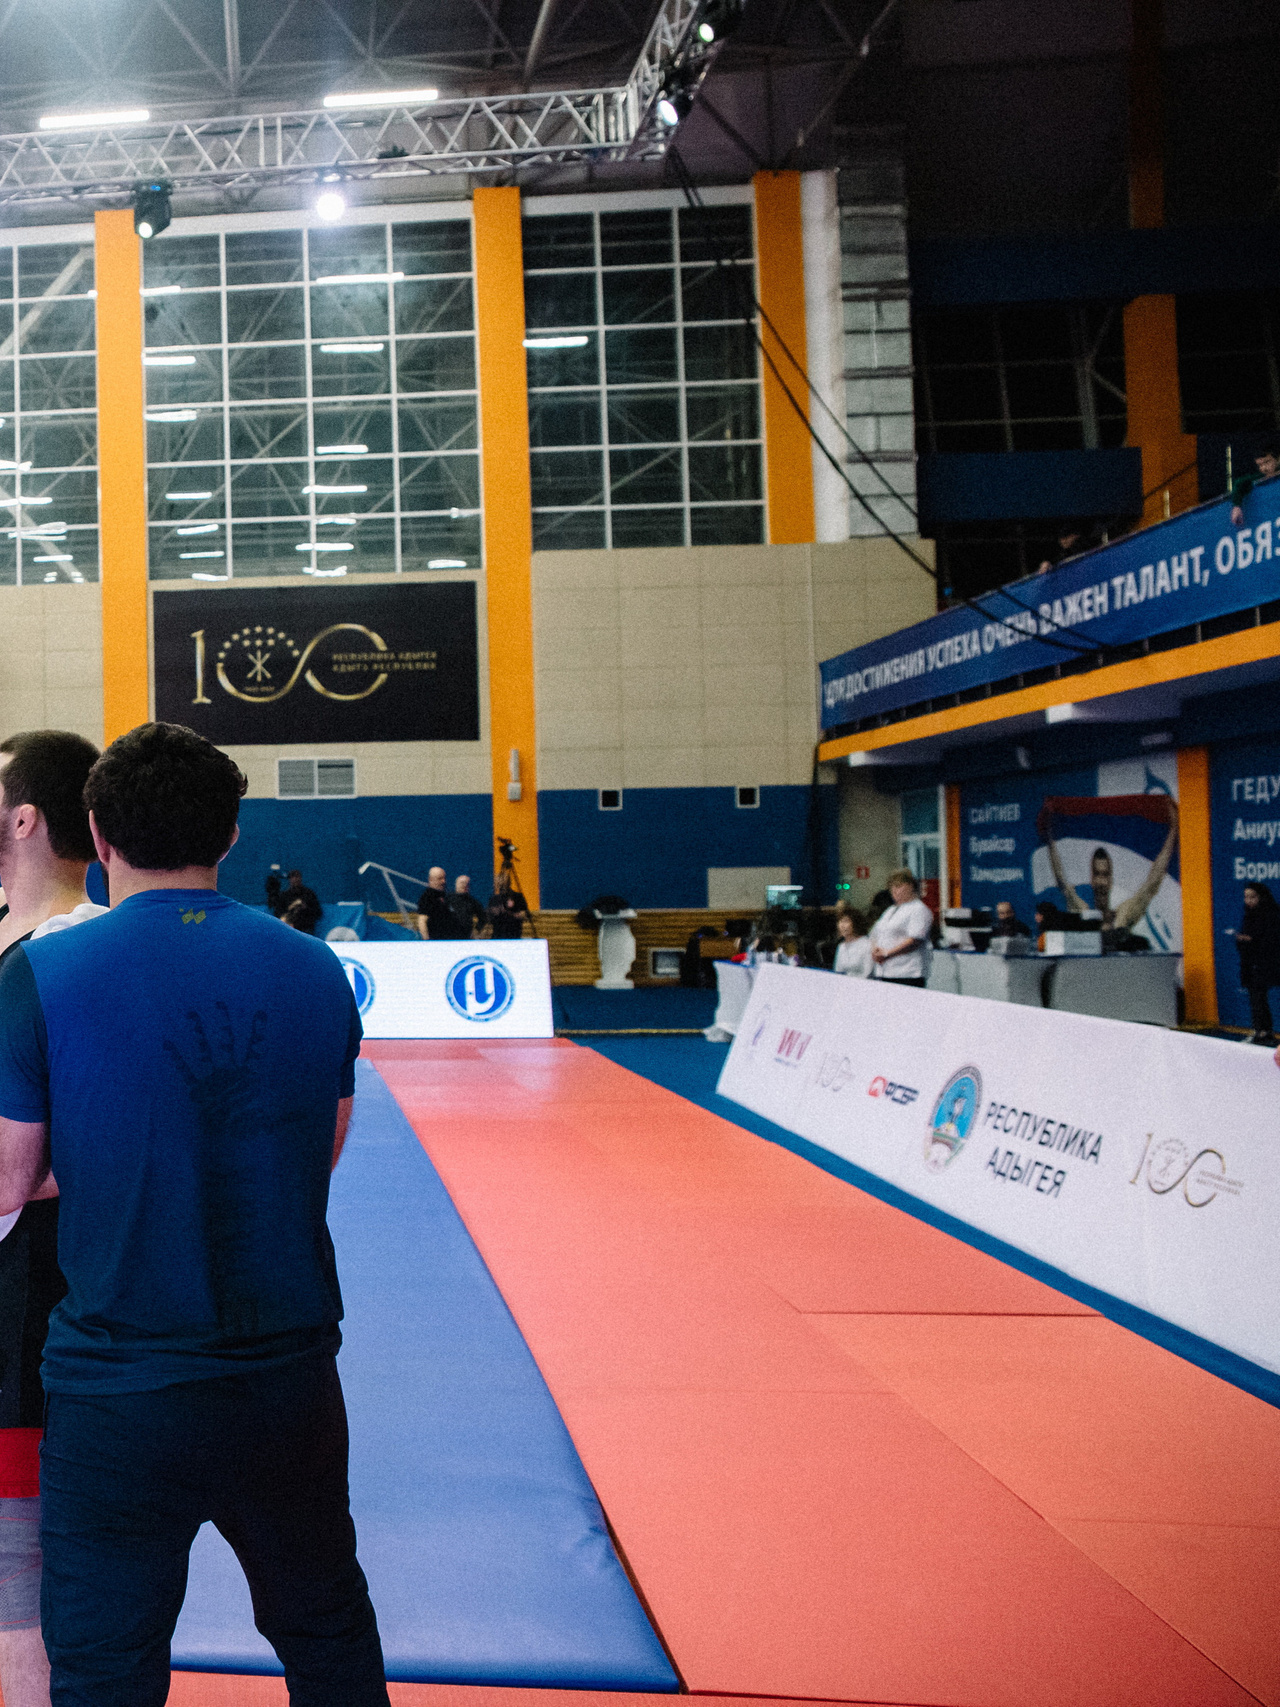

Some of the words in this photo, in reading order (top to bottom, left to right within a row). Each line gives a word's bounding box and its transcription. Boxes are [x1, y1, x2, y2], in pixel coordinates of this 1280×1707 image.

[927, 629, 981, 672] УСПЕХА
[1038, 580, 1109, 636] ВАЖЕН
[1110, 545, 1210, 610] ТАЛАНТ,
[983, 1101, 1104, 1165] РЕСПУБЛИКА
[984, 1146, 1068, 1200] АДЫГЕЯ
